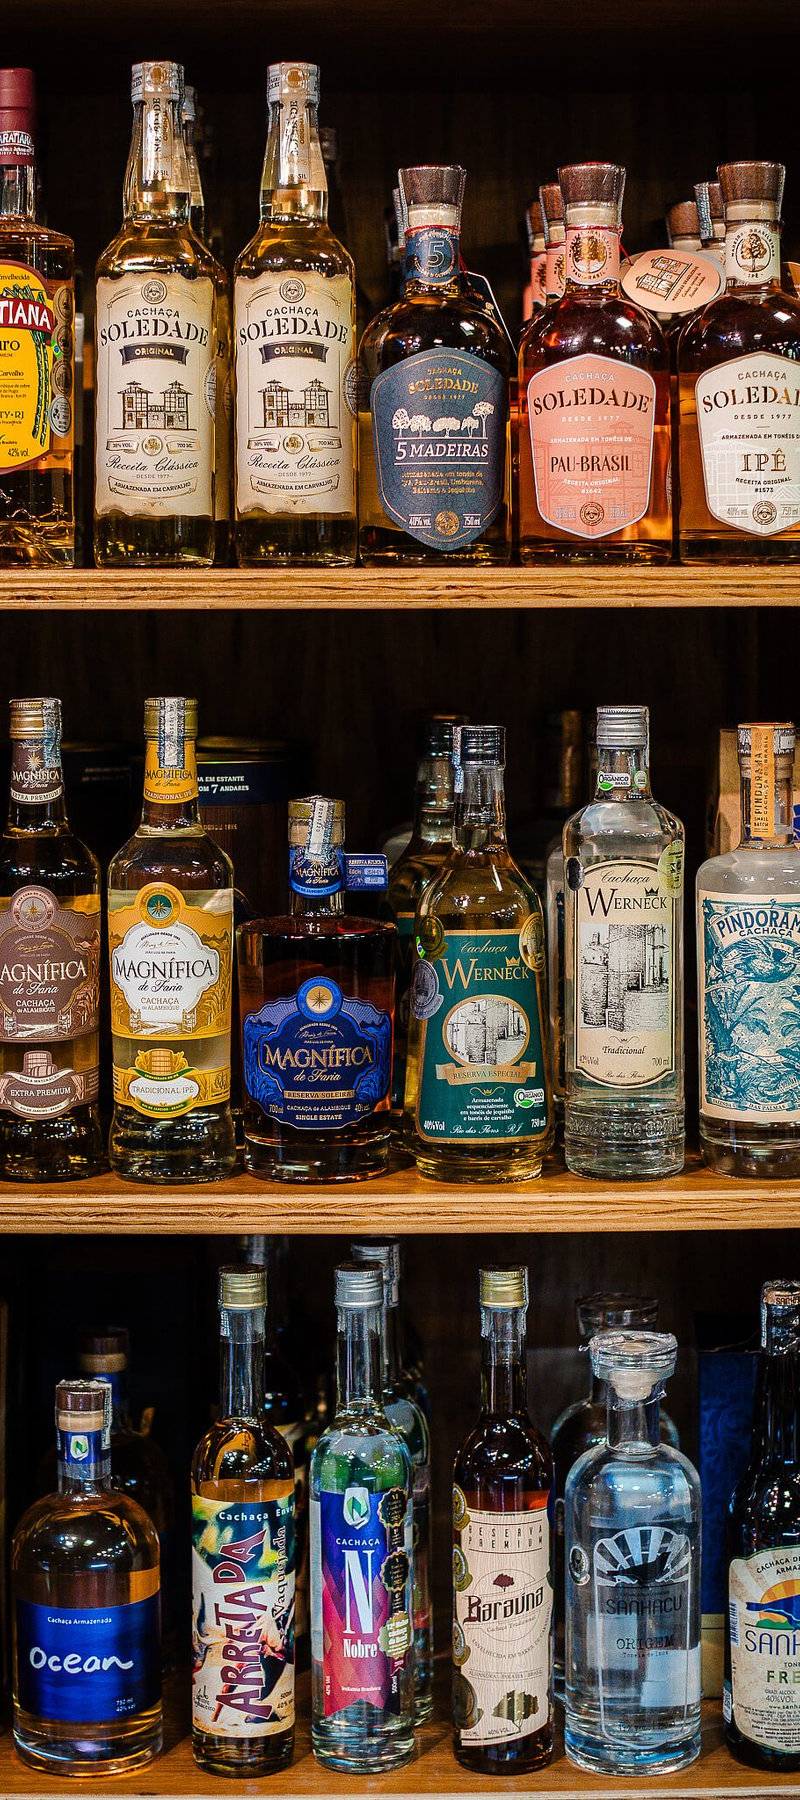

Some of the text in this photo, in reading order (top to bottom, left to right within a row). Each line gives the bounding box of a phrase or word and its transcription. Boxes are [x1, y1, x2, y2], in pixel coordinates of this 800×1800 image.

[427, 241, 445, 267] 5
[127, 308, 180, 319] CACHAÇA
[266, 306, 319, 317] CACHAÇA
[100, 318, 209, 347] SOLEDADE
[239, 317, 348, 345] SOLEDADE
[134, 348, 174, 357] ORIGINAL
[274, 346, 313, 355] ORIGINAL
[565, 373, 616, 382] CACHAÇA
[738, 371, 787, 381] CACHAÇA
[408, 377, 479, 395] SOLEDADE
[533, 387, 650, 416] SOLEDADE
[395, 442, 489, 461] 5 MADEIRAS
[106, 455, 199, 472] Receita Clássica
[247, 453, 342, 470] Receita Clássica
[551, 455, 633, 473] PAU-BRASIL
[740, 447, 787, 472] IPÊ
[114, 482, 152, 492] ARMAZENADA
[162, 482, 191, 492] CARVALHO
[256, 480, 294, 491] ARMAZENADA
[304, 479, 334, 490] CARVALHO
[736, 476, 792, 486] RECEITA ORIGINAL
[216, 775, 245, 783] ESTANTE
[754, 752, 763, 815] PINDORAMA
[145, 789, 183, 800] TRADICIONAL
[210, 784, 219, 794] 7
[600, 869, 651, 884] Cachaça
[583, 886, 668, 917] WERNECK
[739, 927, 792, 938] CACHAÇA
[460, 939, 509, 954] Cachaça
[0, 959, 87, 983] AGNÍFICA
[115, 956, 214, 982] MAGNÍFICA
[441, 957, 530, 990] WERNECK
[12, 980, 60, 995] de Faria
[138, 979, 183, 992] de Faria
[16, 999, 56, 1009] CACHAÇA
[140, 996, 180, 1005] CACHAÇA
[602, 1045, 647, 1055] Tradicional
[264, 1044, 373, 1070] MAGNÍFICA
[652, 1056, 663, 1067] 700
[293, 1069, 342, 1082] de Faria
[453, 1070, 523, 1080] RESERVA ESPECIAL
[10, 1087, 71, 1097] EXTRA PREMIUM
[132, 1085, 195, 1095] TRADICIONAL IPÊ
[288, 1091, 352, 1099] RESERVA SOLEIRA
[286, 1104, 312, 1112] CACHAÇA
[450, 1124, 500, 1134] Rio das Flores
[218, 1511, 270, 1523] Cachaça
[467, 1525, 543, 1538] RESERVA
[336, 1537, 381, 1547] CACHAÇA
[467, 1537, 543, 1549] PREMIUM
[272, 1525, 287, 1619] Vaquejada
[341, 1549, 375, 1634] N
[47, 1616, 113, 1625] Cachaça Armazenada
[212, 1528, 274, 1721] ARRETADA
[343, 1638, 378, 1659] Nobre
[616, 1634, 675, 1650] ORIGEM
[29, 1646, 134, 1674] Ocean
